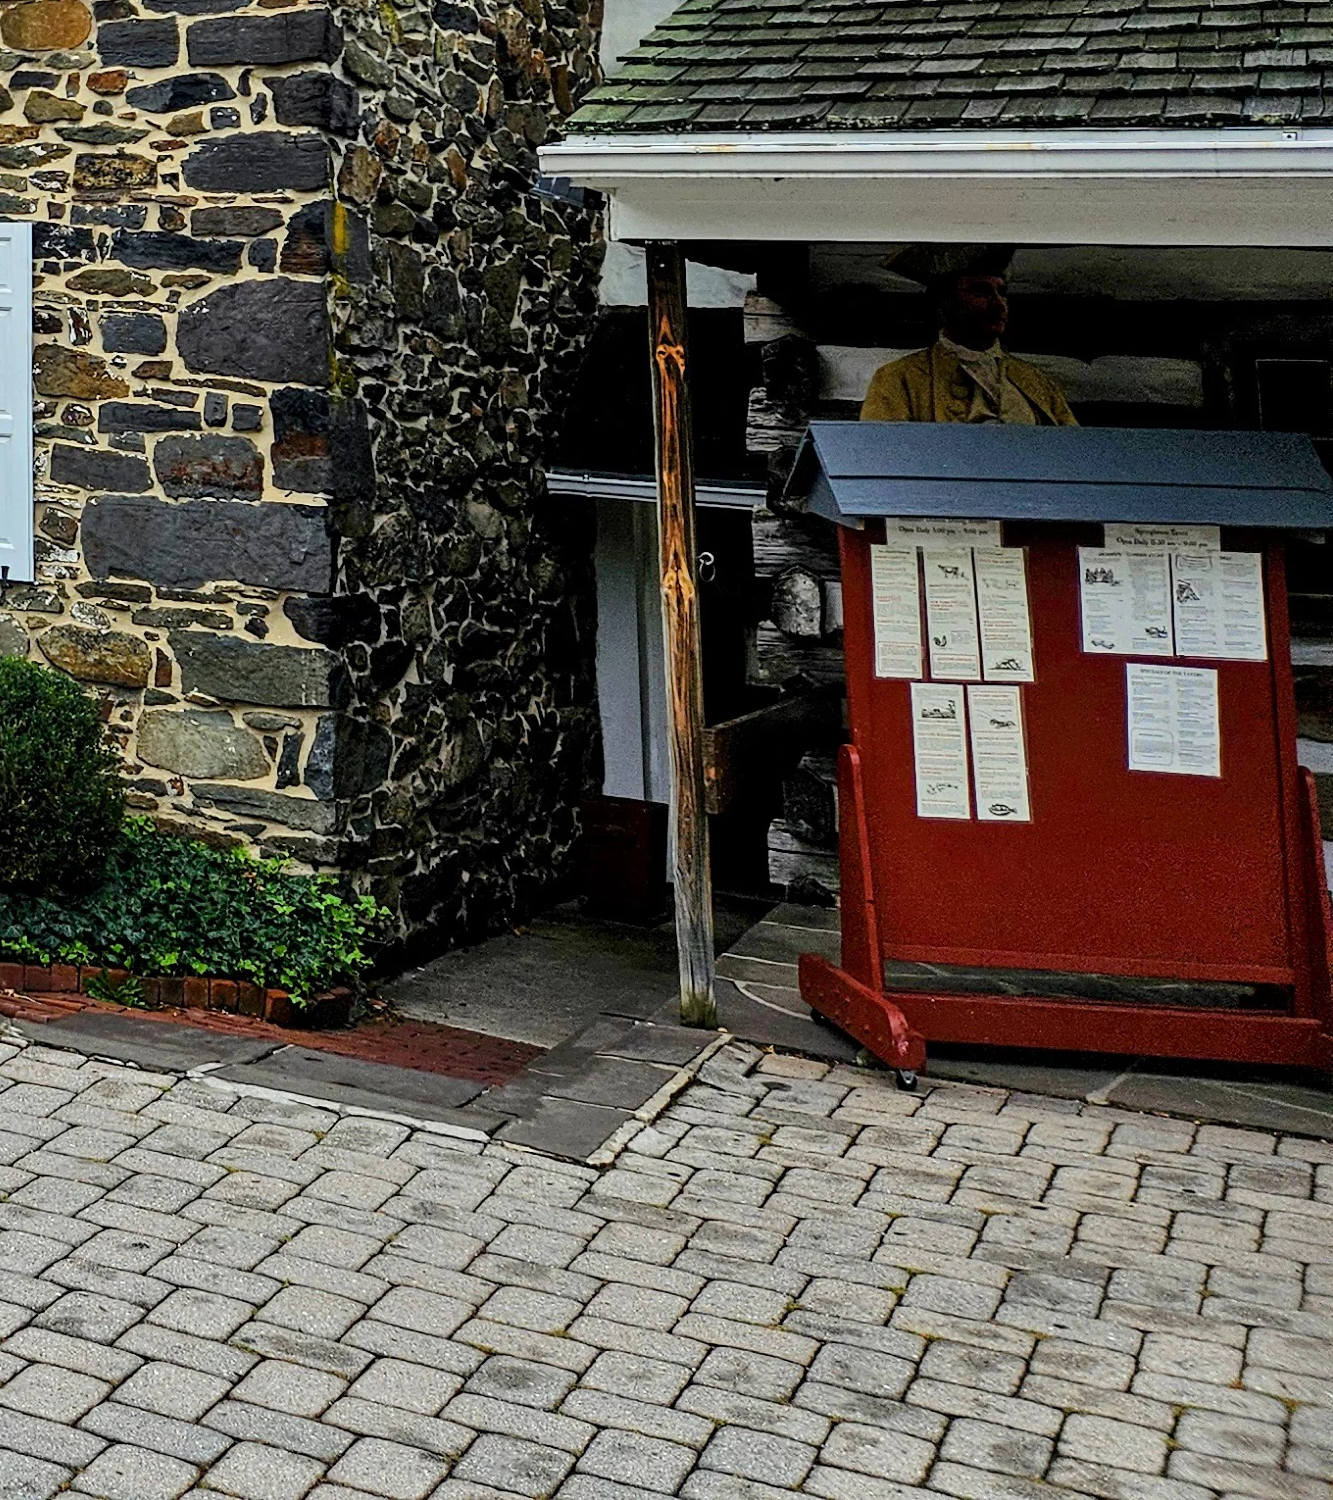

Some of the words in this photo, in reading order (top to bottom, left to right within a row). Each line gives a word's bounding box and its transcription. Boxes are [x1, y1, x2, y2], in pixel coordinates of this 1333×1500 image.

[898, 525, 914, 534] Open
[916, 526, 930, 535] Daily
[1117, 536, 1132, 545] Open
[1134, 537, 1148, 547] Daily
